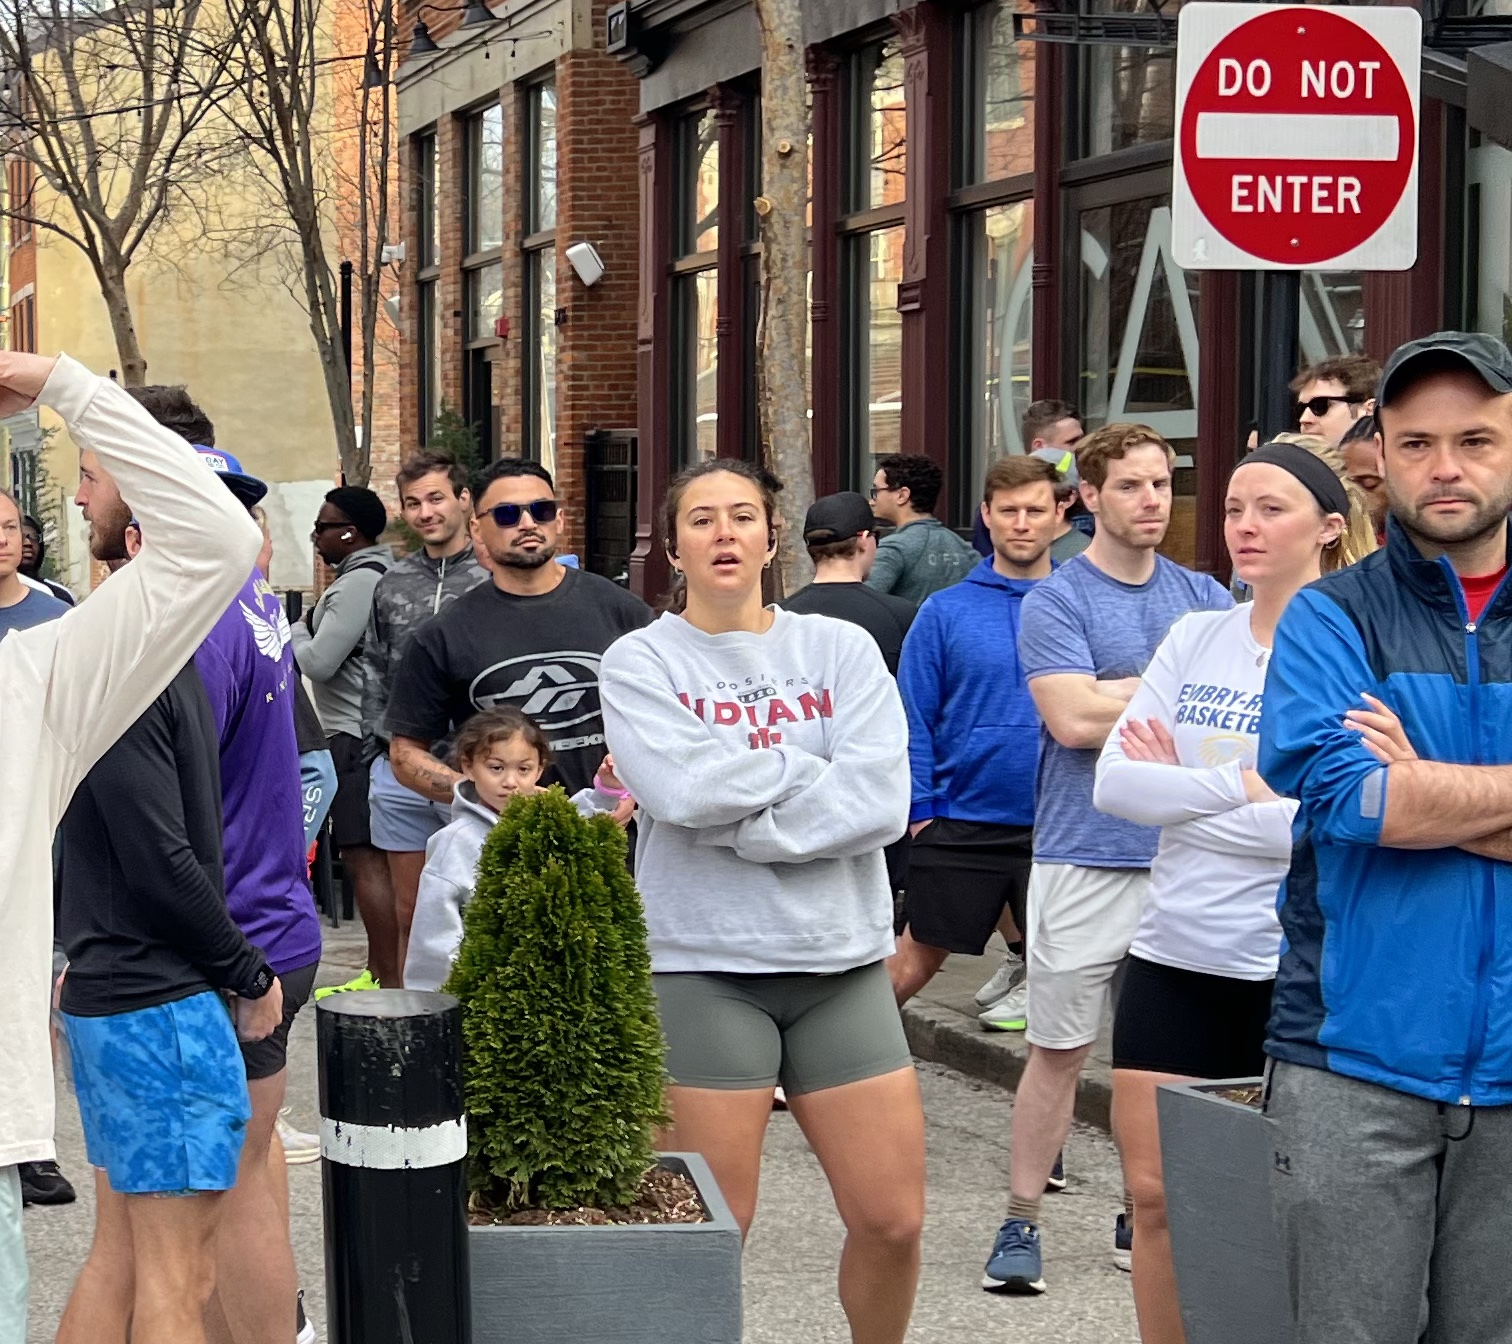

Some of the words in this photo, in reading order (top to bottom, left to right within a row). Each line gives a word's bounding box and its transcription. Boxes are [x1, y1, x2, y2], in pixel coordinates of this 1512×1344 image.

[1218, 58, 1272, 97] DO
[1301, 60, 1381, 99] NOT
[1231, 174, 1362, 214] ENTER
[705, 674, 809, 692] OOSIRS
[1176, 704, 1260, 734] BASKETB
